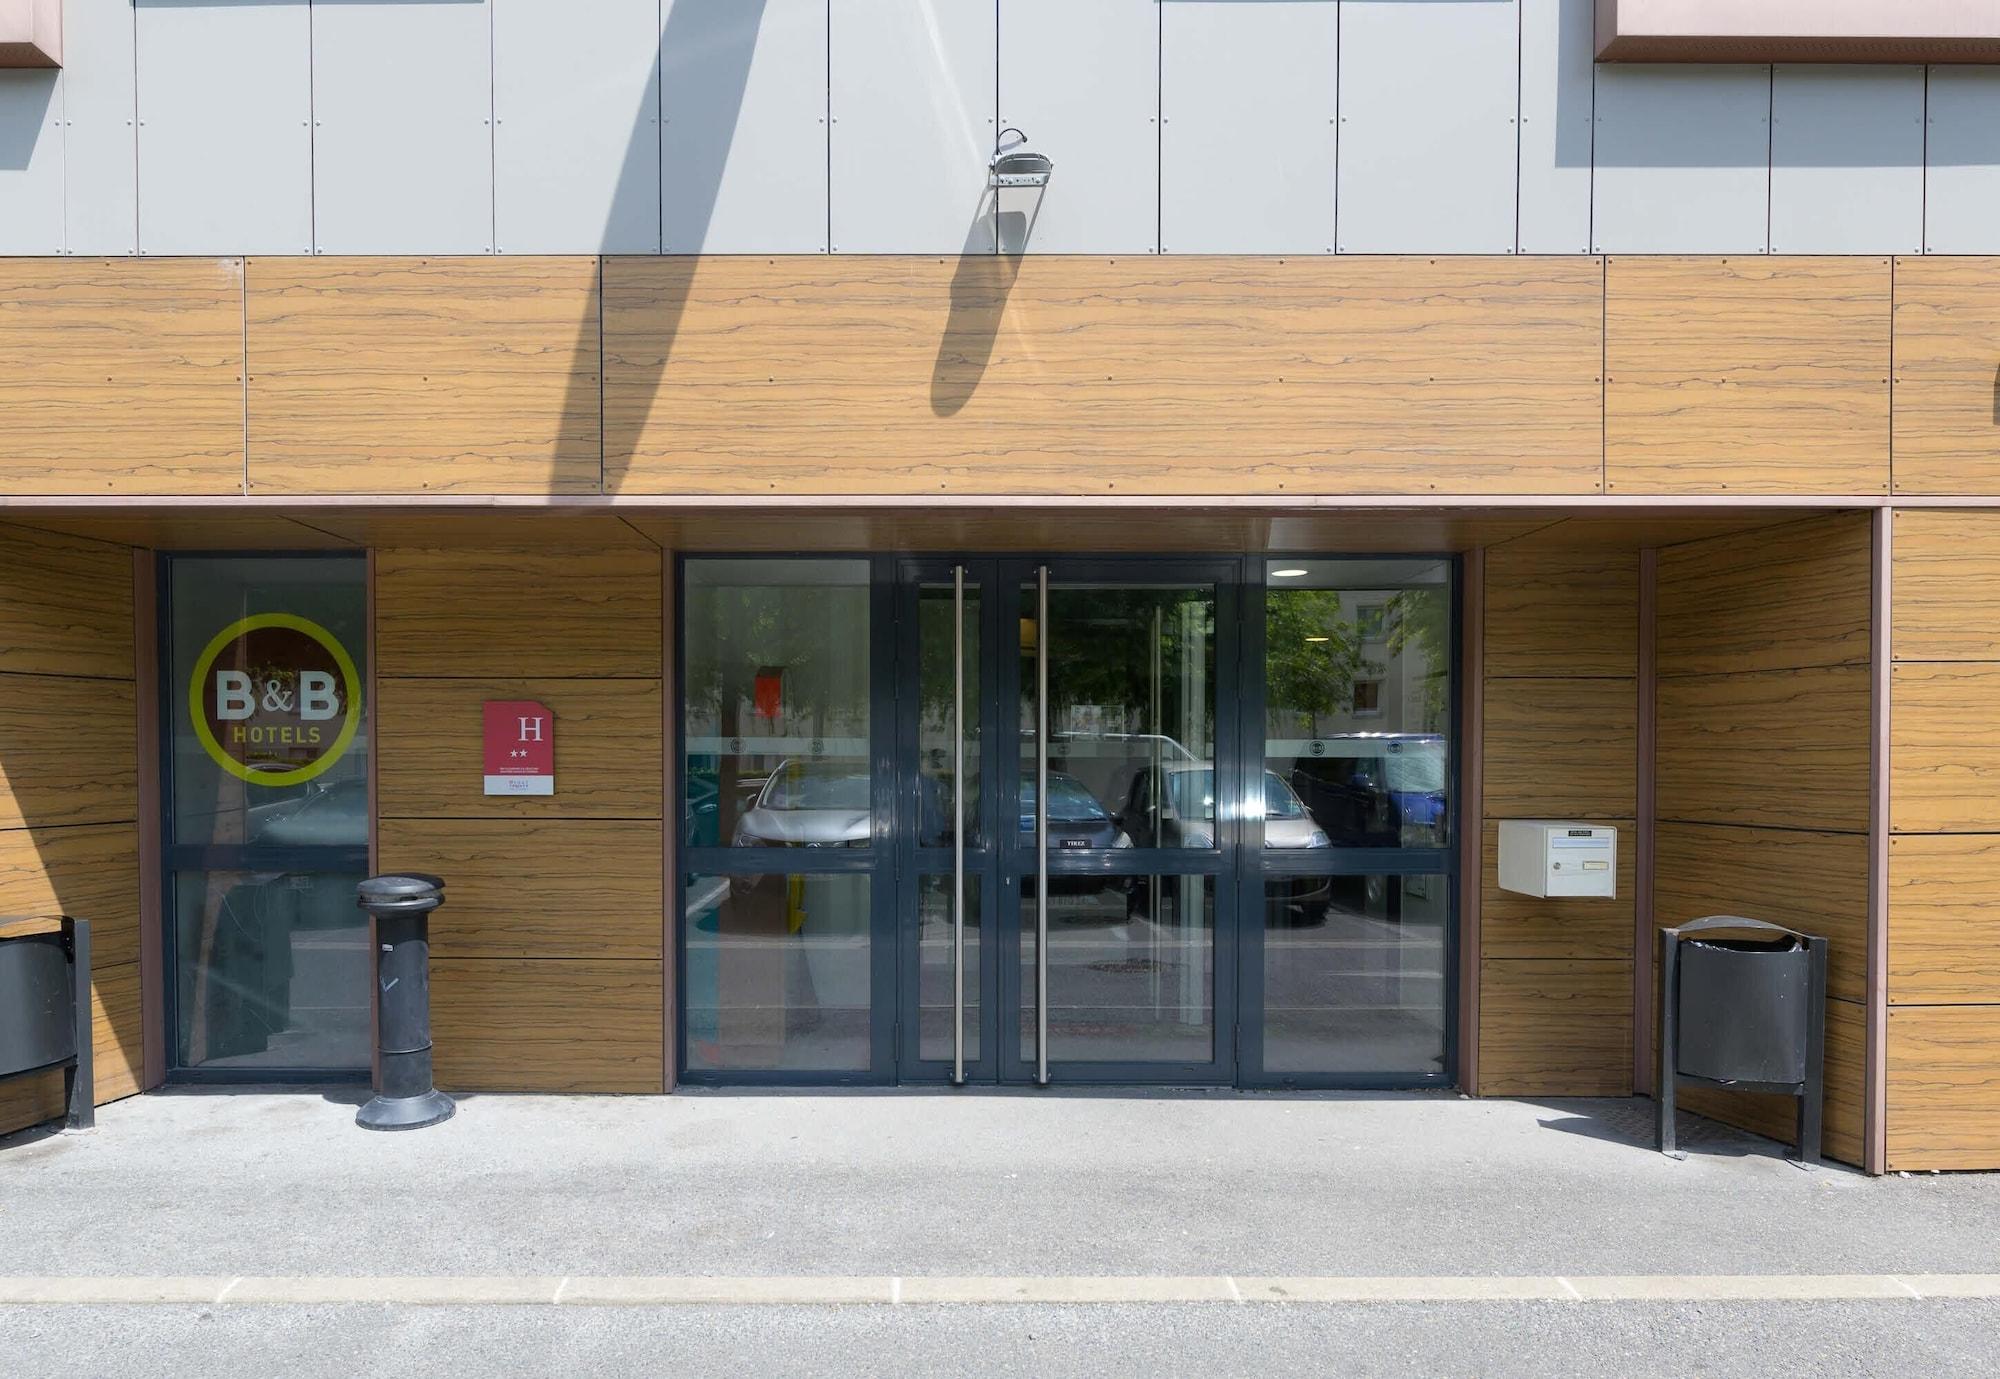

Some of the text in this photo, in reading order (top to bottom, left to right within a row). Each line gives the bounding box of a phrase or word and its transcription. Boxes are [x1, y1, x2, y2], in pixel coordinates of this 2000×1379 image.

[216, 670, 339, 720] B&B
[233, 726, 321, 744] HOTELS
[517, 716, 544, 742] H
